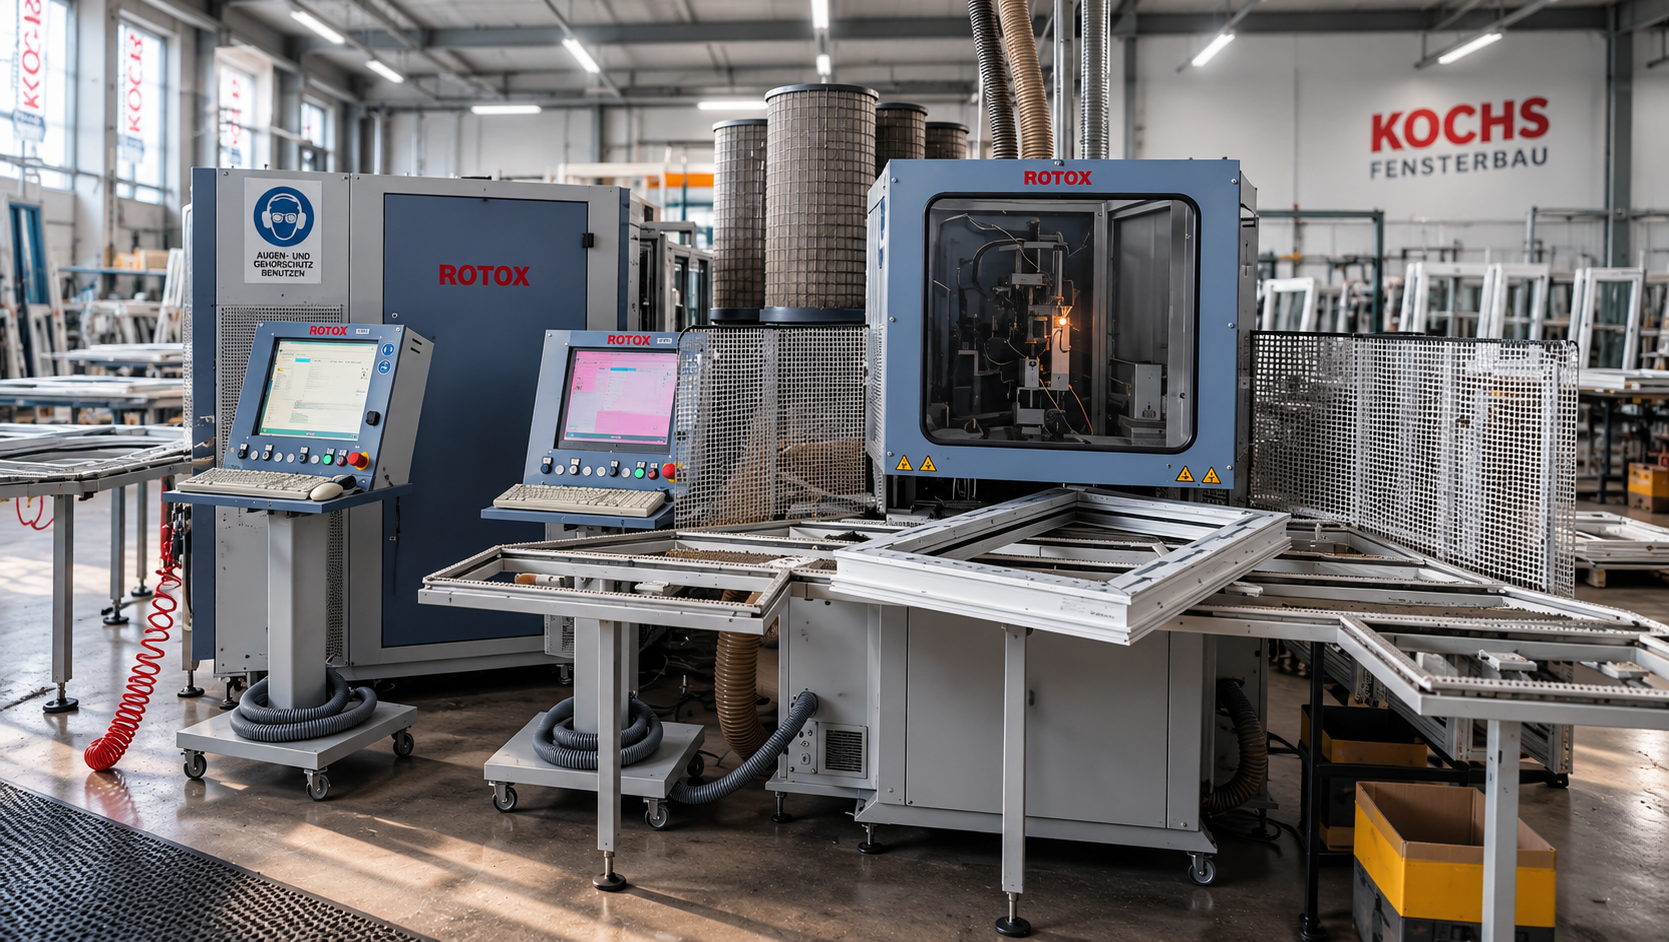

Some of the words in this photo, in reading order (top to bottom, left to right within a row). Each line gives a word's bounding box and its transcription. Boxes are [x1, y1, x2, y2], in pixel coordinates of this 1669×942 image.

[1371, 96, 1550, 153] KOCHS
[1370, 146, 1549, 181] FENSTERBAU
[1024, 170, 1093, 186] ROTOX
[256, 251, 289, 260] AUGEN-
[292, 252, 311, 260] UND
[261, 269, 305, 277] BENUTZEN
[439, 264, 531, 287] ROTOX
[309, 325, 348, 336] ROTOX
[607, 334, 651, 346] ROTOX
